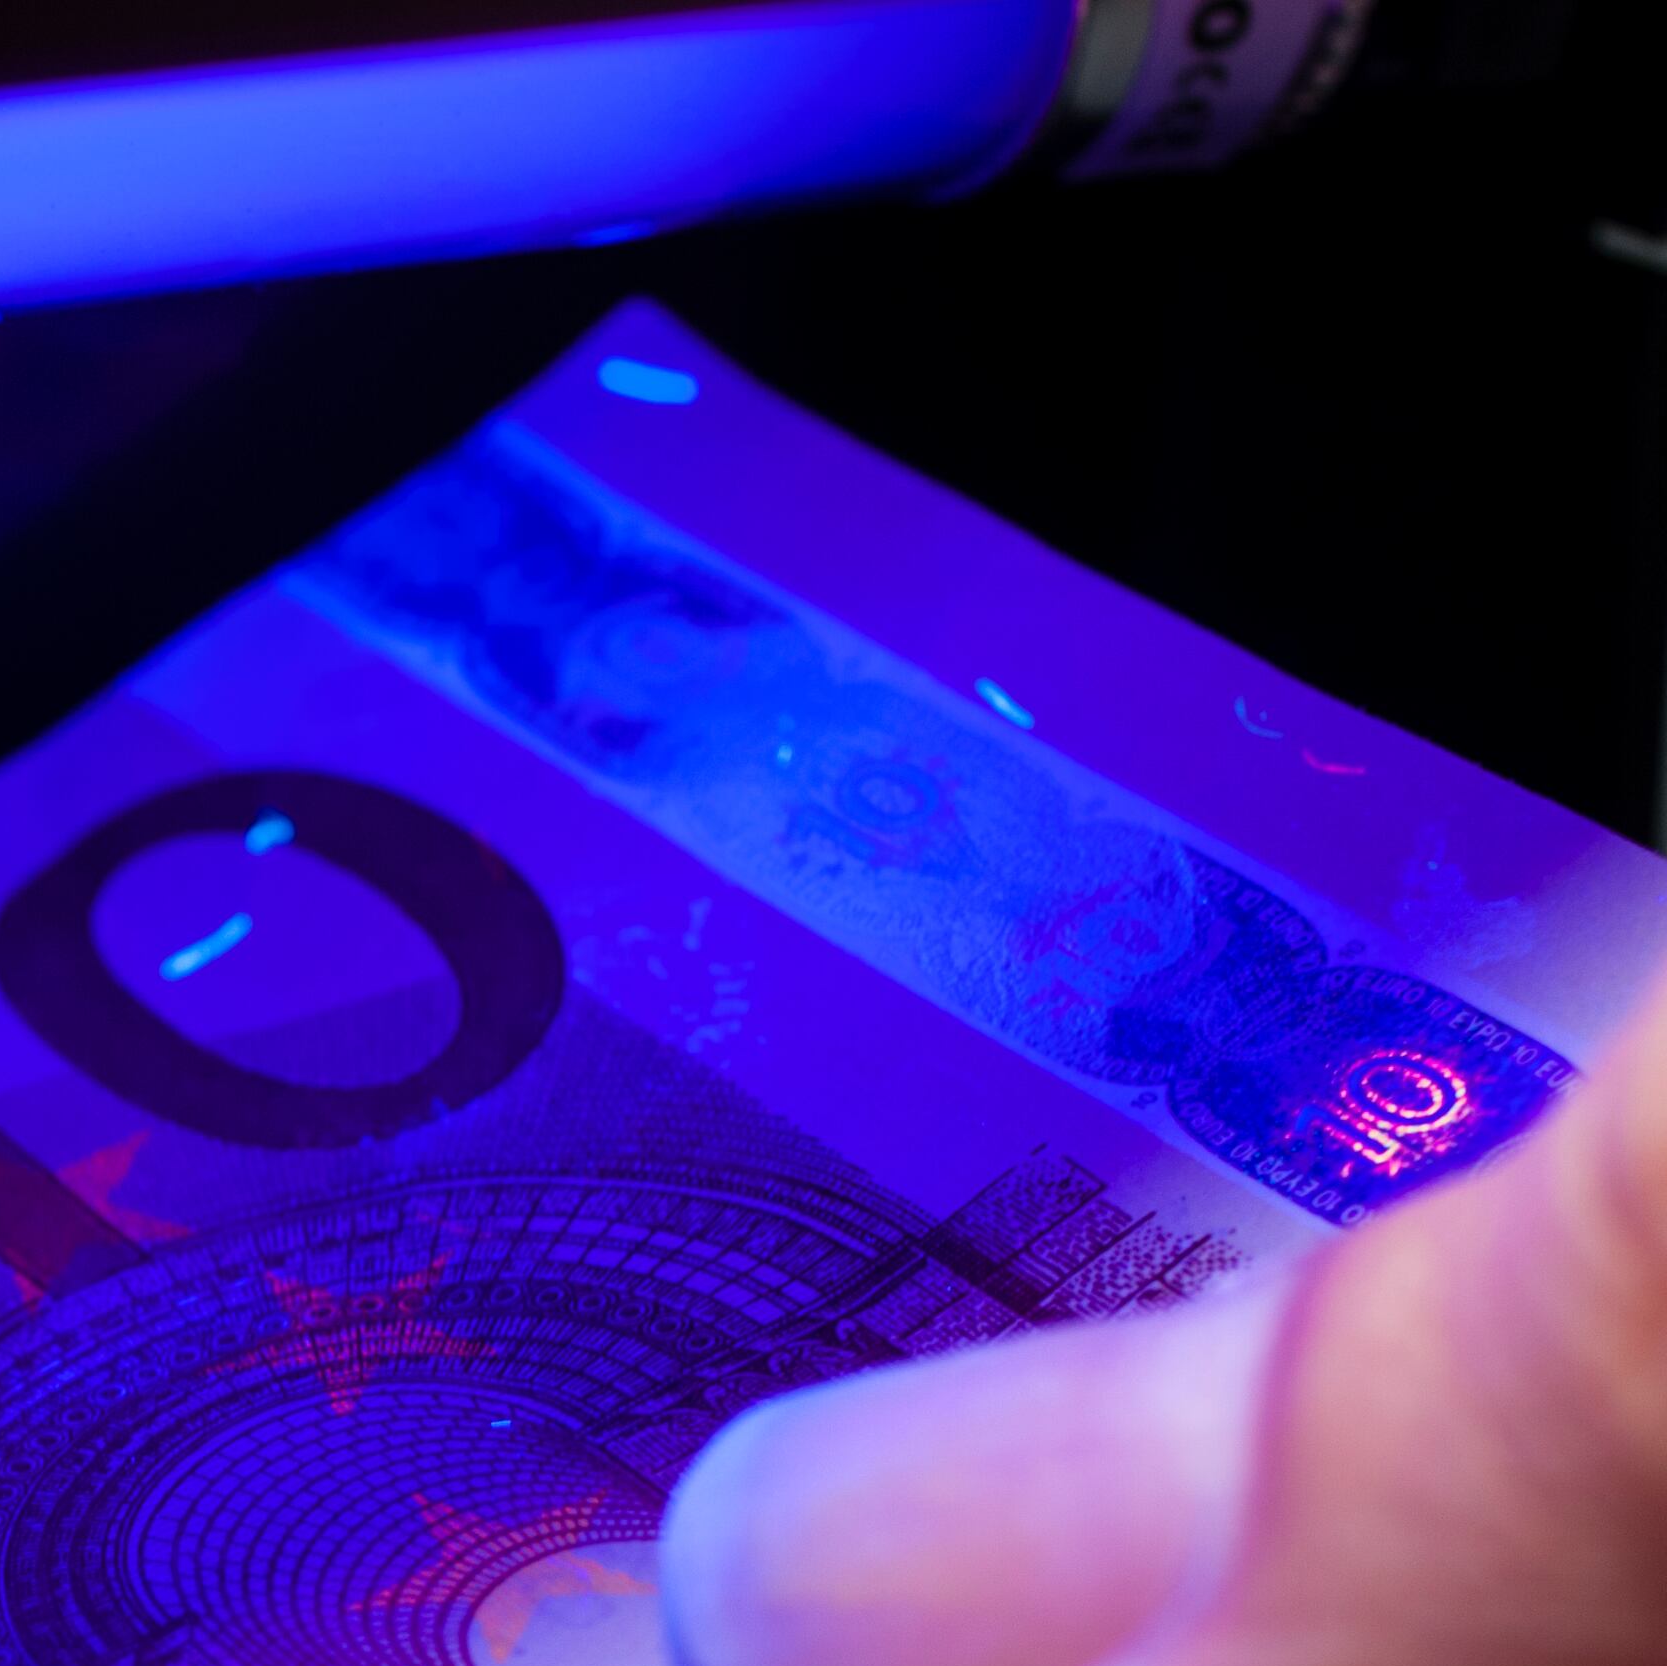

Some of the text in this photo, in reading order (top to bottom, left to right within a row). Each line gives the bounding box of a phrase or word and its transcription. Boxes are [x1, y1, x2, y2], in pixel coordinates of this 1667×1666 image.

[1360, 967, 1428, 1007] EURO
[1512, 1044, 1540, 1067] 10
[1289, 1048, 1470, 1166] 10
[1310, 1188, 1344, 1213] 10
